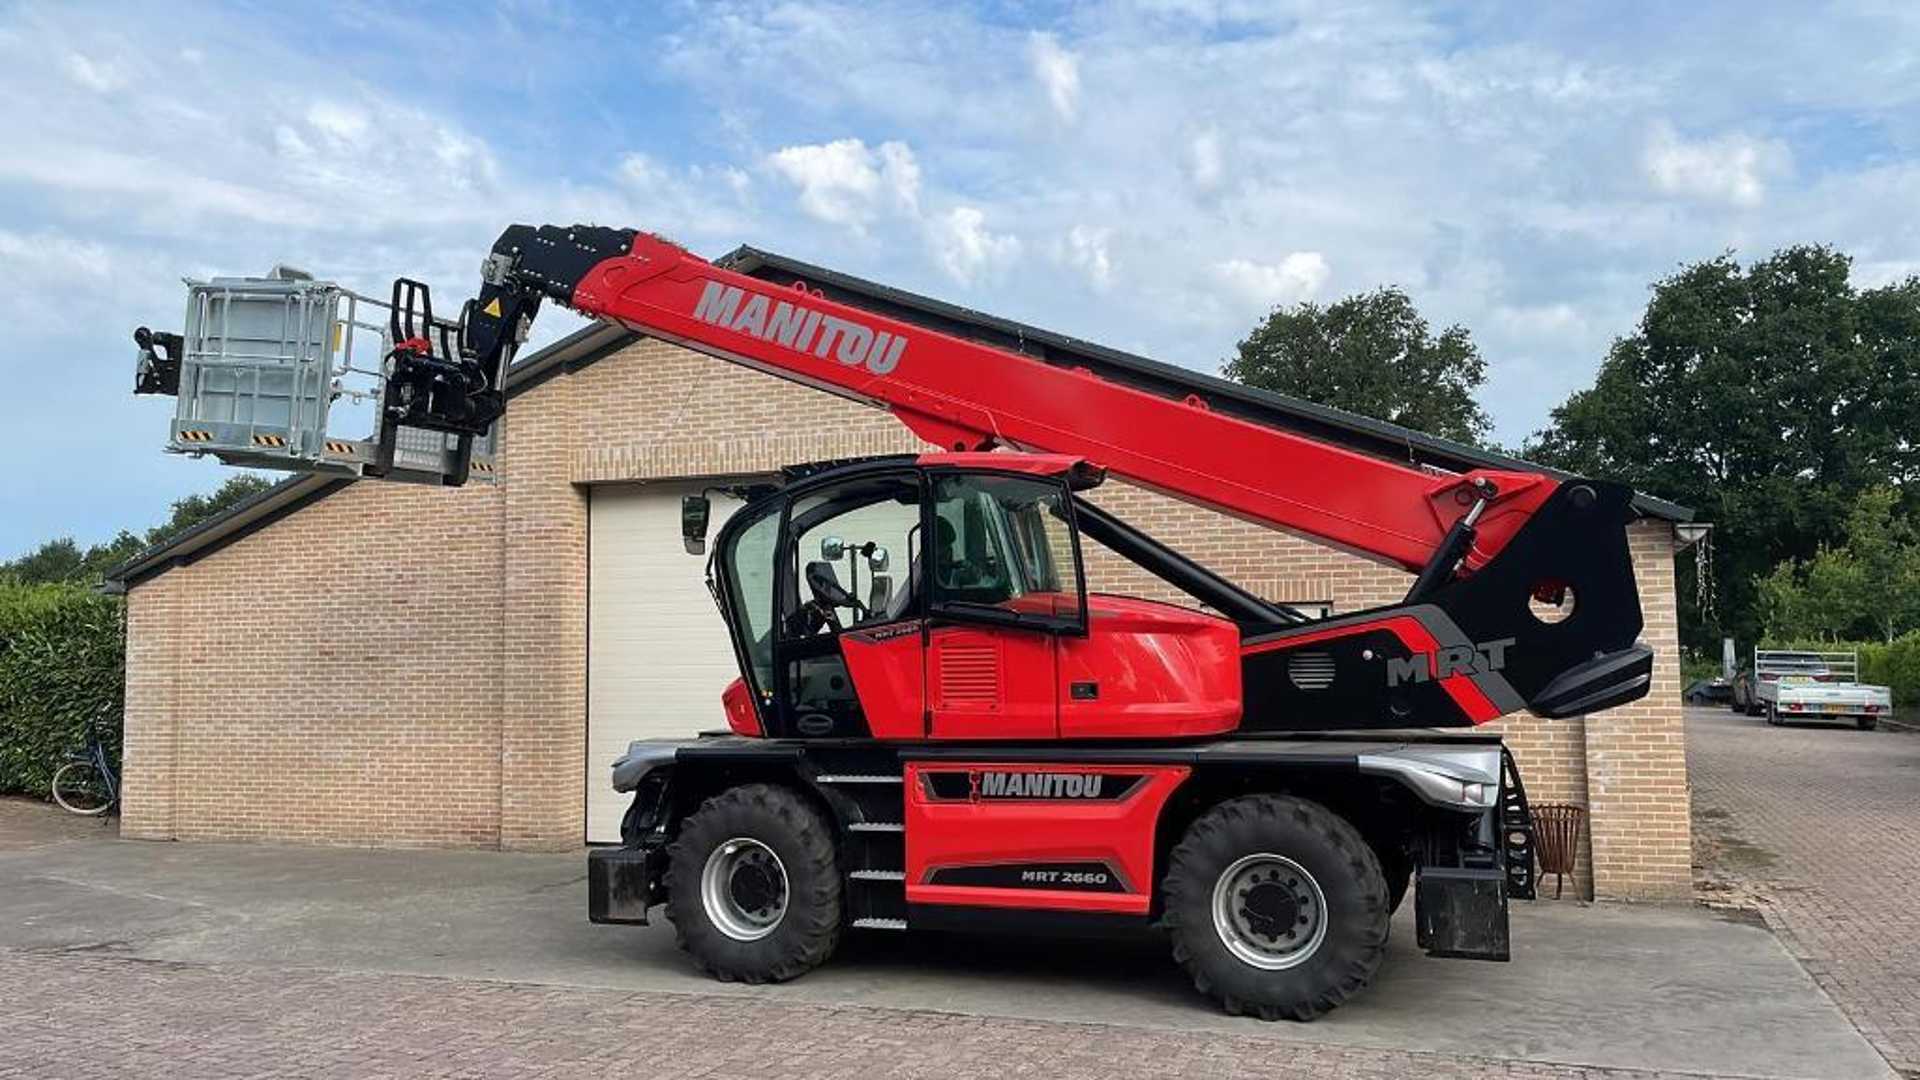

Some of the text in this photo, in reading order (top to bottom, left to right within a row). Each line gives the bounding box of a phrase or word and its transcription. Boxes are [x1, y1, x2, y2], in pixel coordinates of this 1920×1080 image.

[694, 281, 907, 375] MANITOU
[1387, 637, 1516, 687] MRT
[982, 772, 1102, 798] MANITOU
[1021, 870, 1107, 884] MRT 2660
